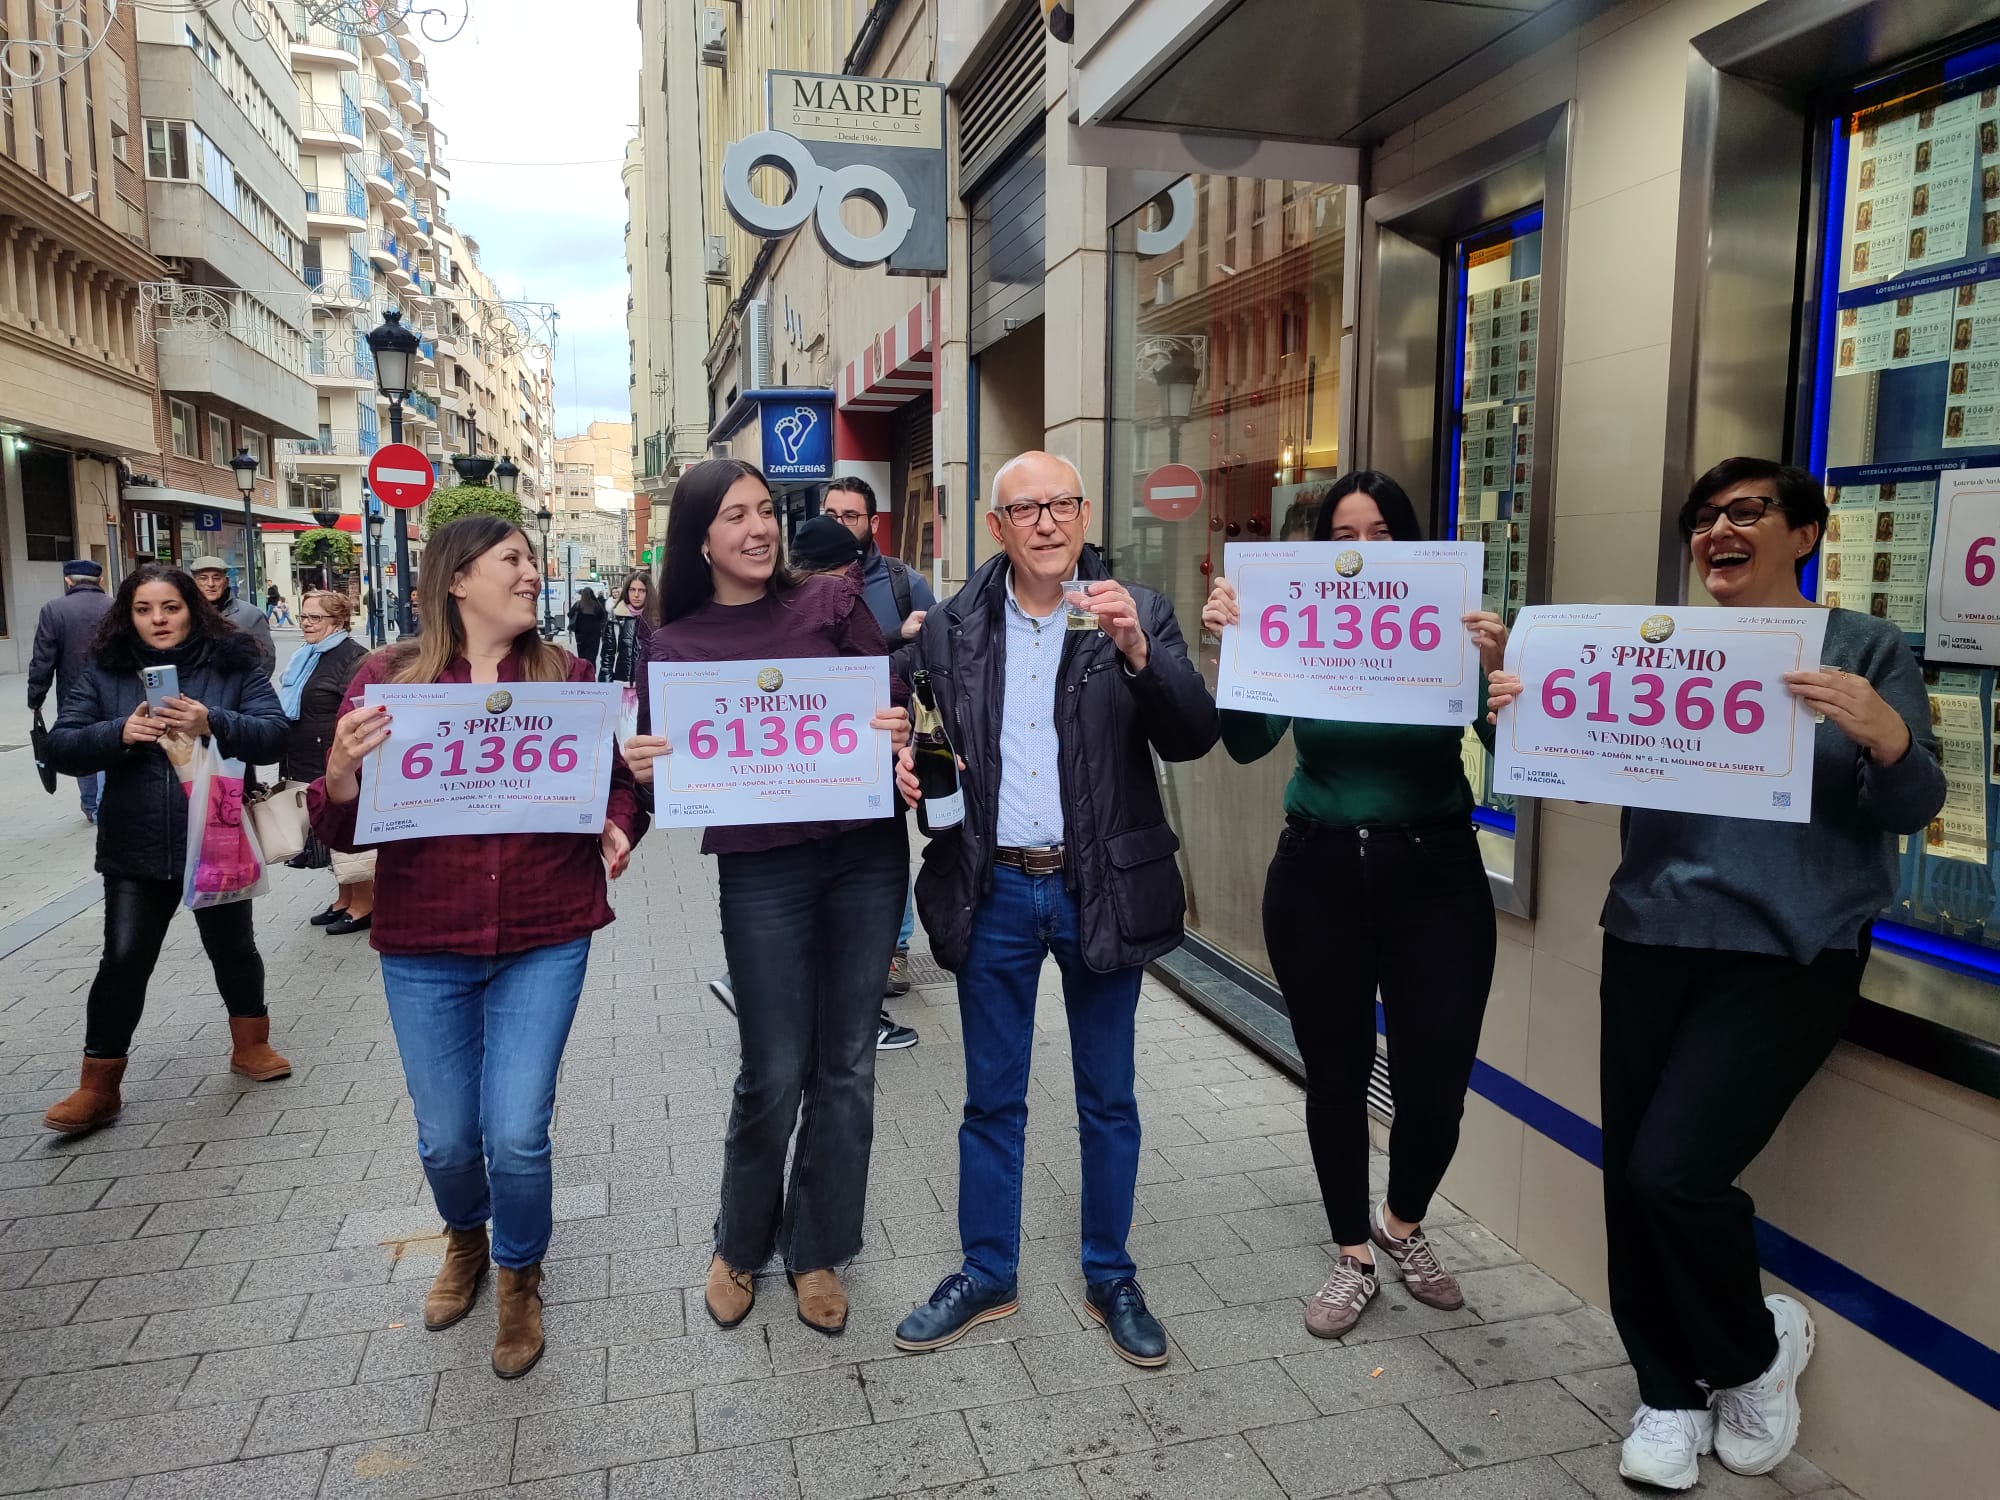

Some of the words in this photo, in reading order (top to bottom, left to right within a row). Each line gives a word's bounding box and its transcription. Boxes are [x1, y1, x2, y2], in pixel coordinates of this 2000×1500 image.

[792, 79, 923, 116] MARPE
[1929, 221, 1955, 234] 06004
[1910, 275, 1939, 288] APUESTAS
[1953, 268, 1977, 278] ESTADO
[1967, 406, 1993, 414] 40646
[770, 464, 826, 473] ZAPATERIAS
[1893, 465, 1921, 473] APUESTAS
[1935, 462, 1958, 470] ESTADO
[1315, 581, 1408, 600] PREMIO
[1260, 604, 1441, 651] 61366
[1299, 657, 1356, 668] VENDIDO
[1360, 656, 1393, 669] AQUÍ
[1612, 645, 1726, 671] PREMIO
[1246, 689, 1273, 697] LOTERÍA
[1246, 695, 1279, 703] NACIONAL
[740, 694, 826, 713] PREMIO
[1541, 669, 1764, 734] 61366
[464, 715, 553, 735] PREMIO
[688, 714, 858, 759] 61366
[1587, 731, 1655, 747] VENDIDO
[1661, 737, 1701, 751] AQUÍ
[1944, 740, 1971, 749] 60850
[401, 735, 578, 779] 61366
[1544, 746, 1568, 754] VENTA
[1602, 750, 1634, 760] ADMÓN.
[1660, 756, 1670, 764] EL
[1672, 758, 1704, 766] MOLINO
[1732, 763, 1765, 772] SUERTE
[730, 764, 783, 775] VENDIDO
[787, 760, 816, 773] AQUÍ
[1527, 770, 1558, 778] LOTERÍA
[1624, 766, 1664, 776] ALBACETE
[440, 780, 496, 792] VENDIDO
[499, 776, 531, 791] AQUÍ
[1527, 776, 1565, 785] NACIONAL
[386, 823, 417, 831] NACIONAL
[1946, 822, 1972, 832] 60850
